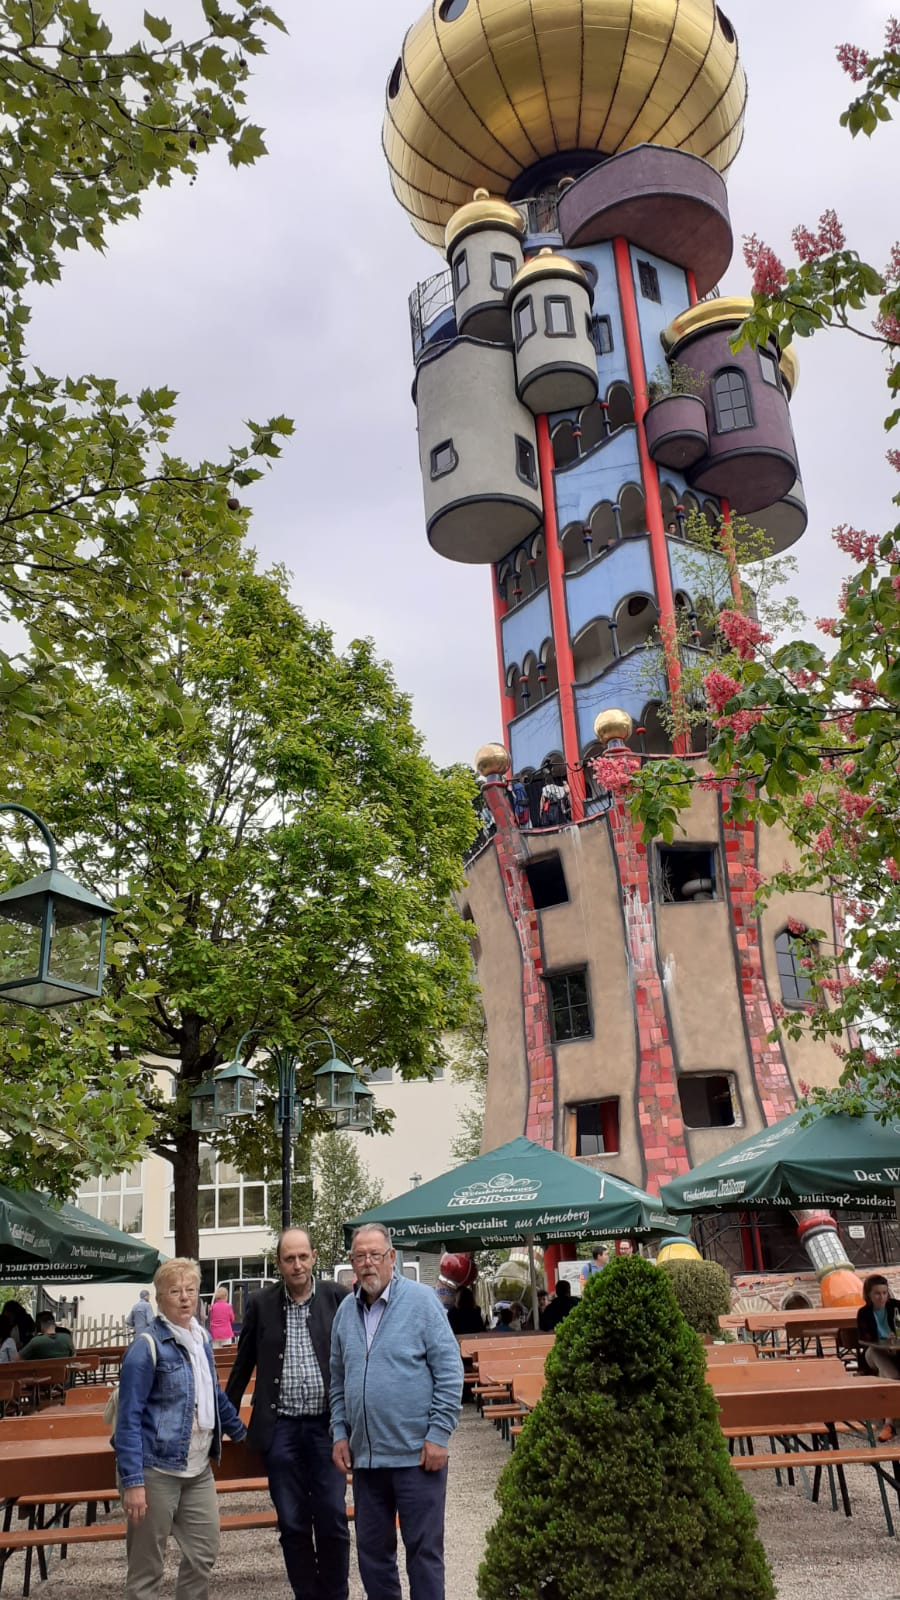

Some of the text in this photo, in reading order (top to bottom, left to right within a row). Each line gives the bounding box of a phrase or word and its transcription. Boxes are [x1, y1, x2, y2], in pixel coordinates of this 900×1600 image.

[853, 1169, 882, 1181] Der
[387, 1209, 590, 1237] Der Weissbier-Spezialist aus Abensberg
